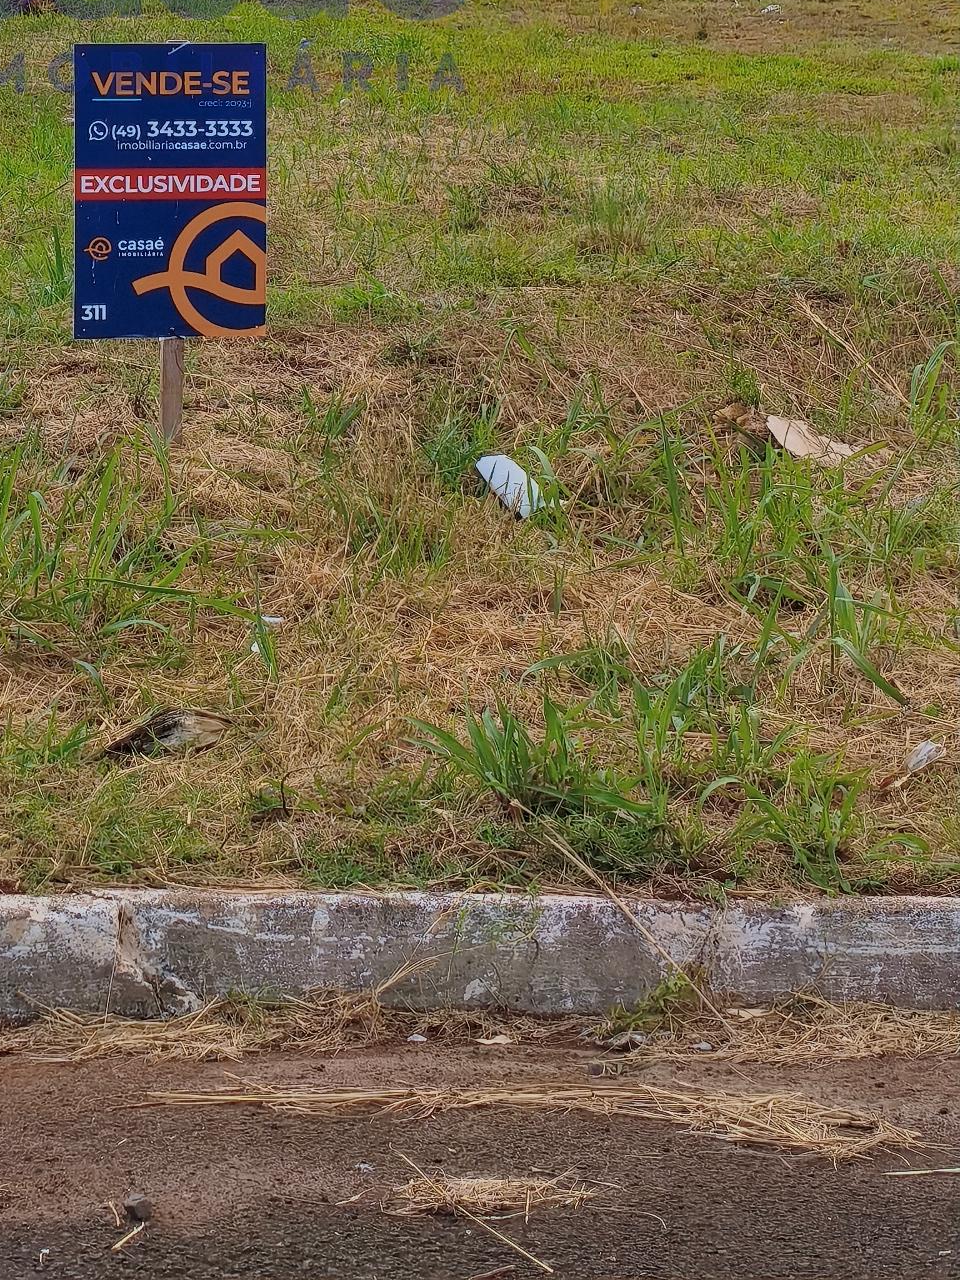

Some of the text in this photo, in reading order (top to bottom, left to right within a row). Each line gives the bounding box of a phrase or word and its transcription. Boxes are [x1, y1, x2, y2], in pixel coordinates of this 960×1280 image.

[91, 70, 250, 95] VENDE-SE
[111, 120, 253, 140] (49) 3433-3333
[117, 140, 248, 150] imobiliariacasae.com.br
[80, 174, 261, 193] EXCLUSIVIDADE
[117, 236, 165, 250] casaé
[81, 304, 107, 320] 311
